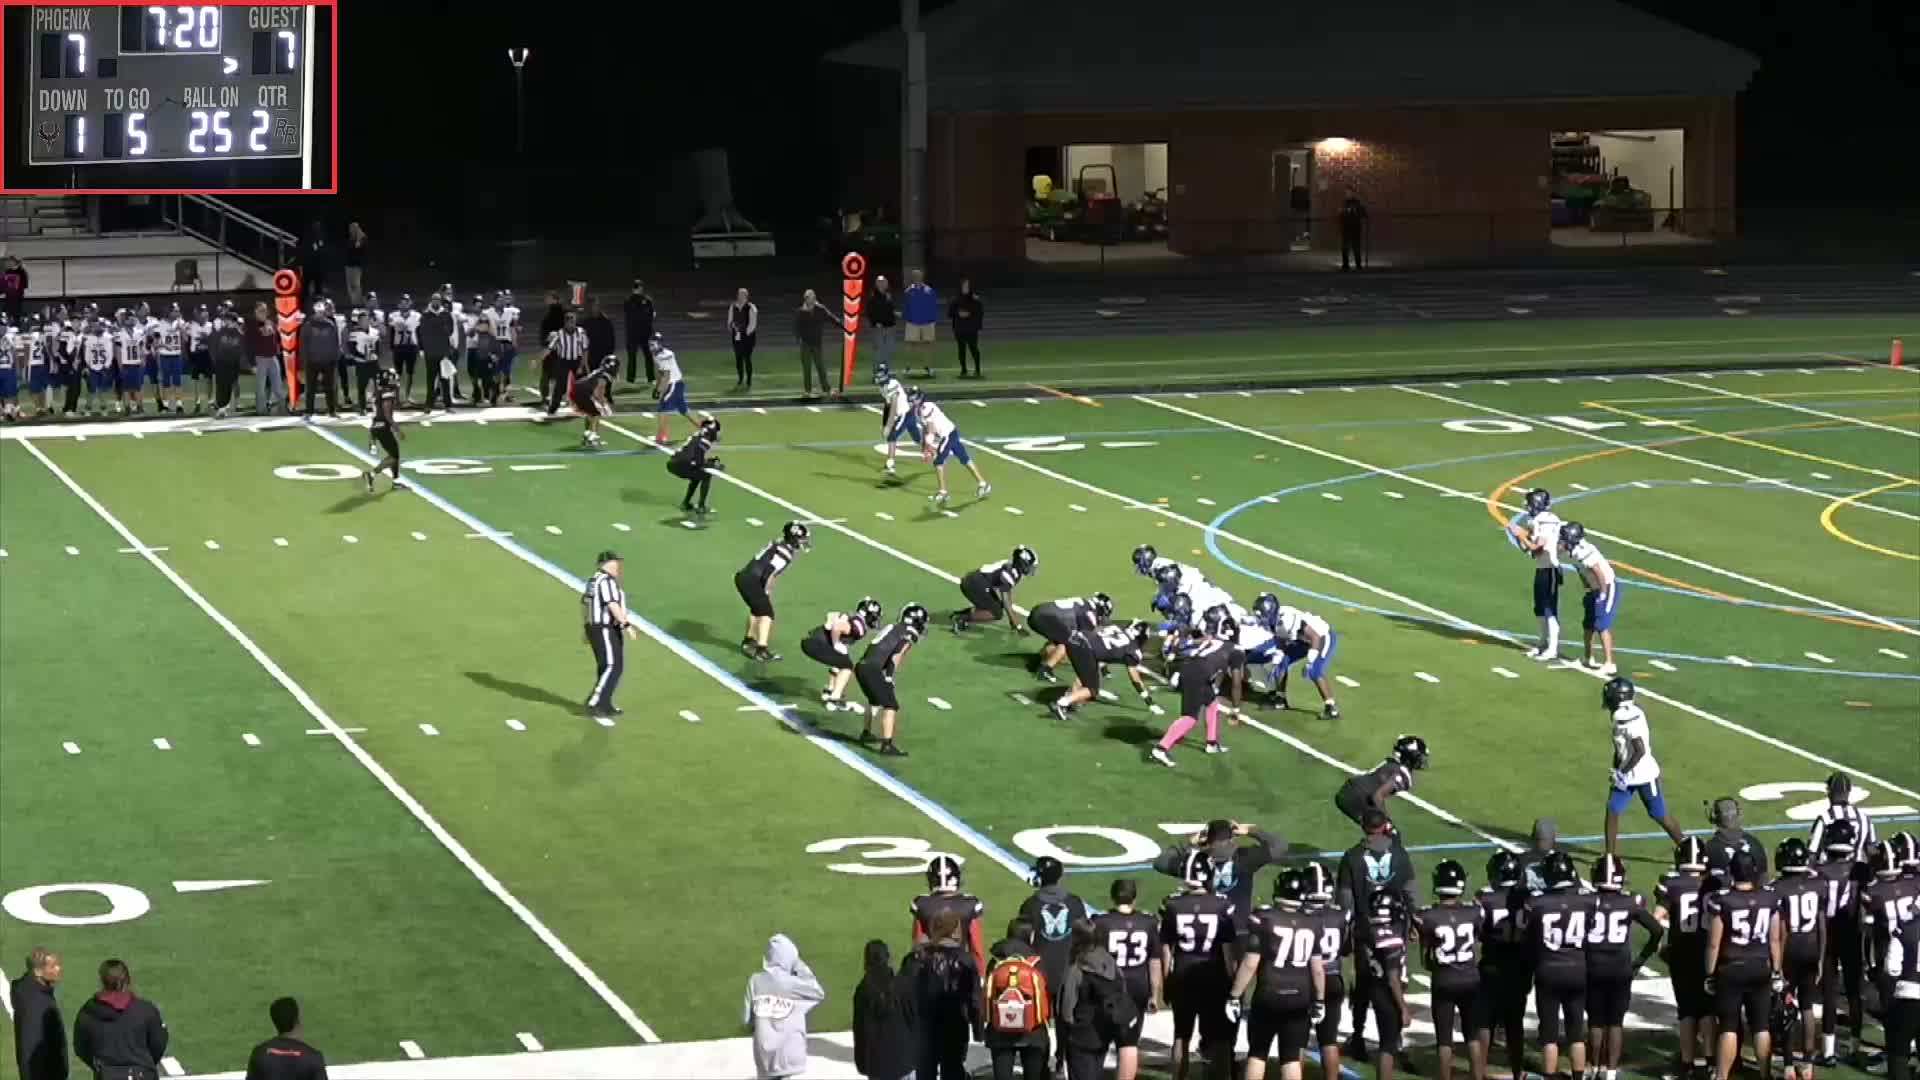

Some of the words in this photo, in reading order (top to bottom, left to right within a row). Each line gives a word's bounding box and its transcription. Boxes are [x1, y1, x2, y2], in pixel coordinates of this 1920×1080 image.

[1731, 908, 1771, 945] 54
[1789, 891, 1818, 933] 19
[1108, 931, 1148, 967] 53
[1176, 914, 1218, 952] 57
[1273, 925, 1315, 968] 70
[1434, 922, 1475, 965] 22
